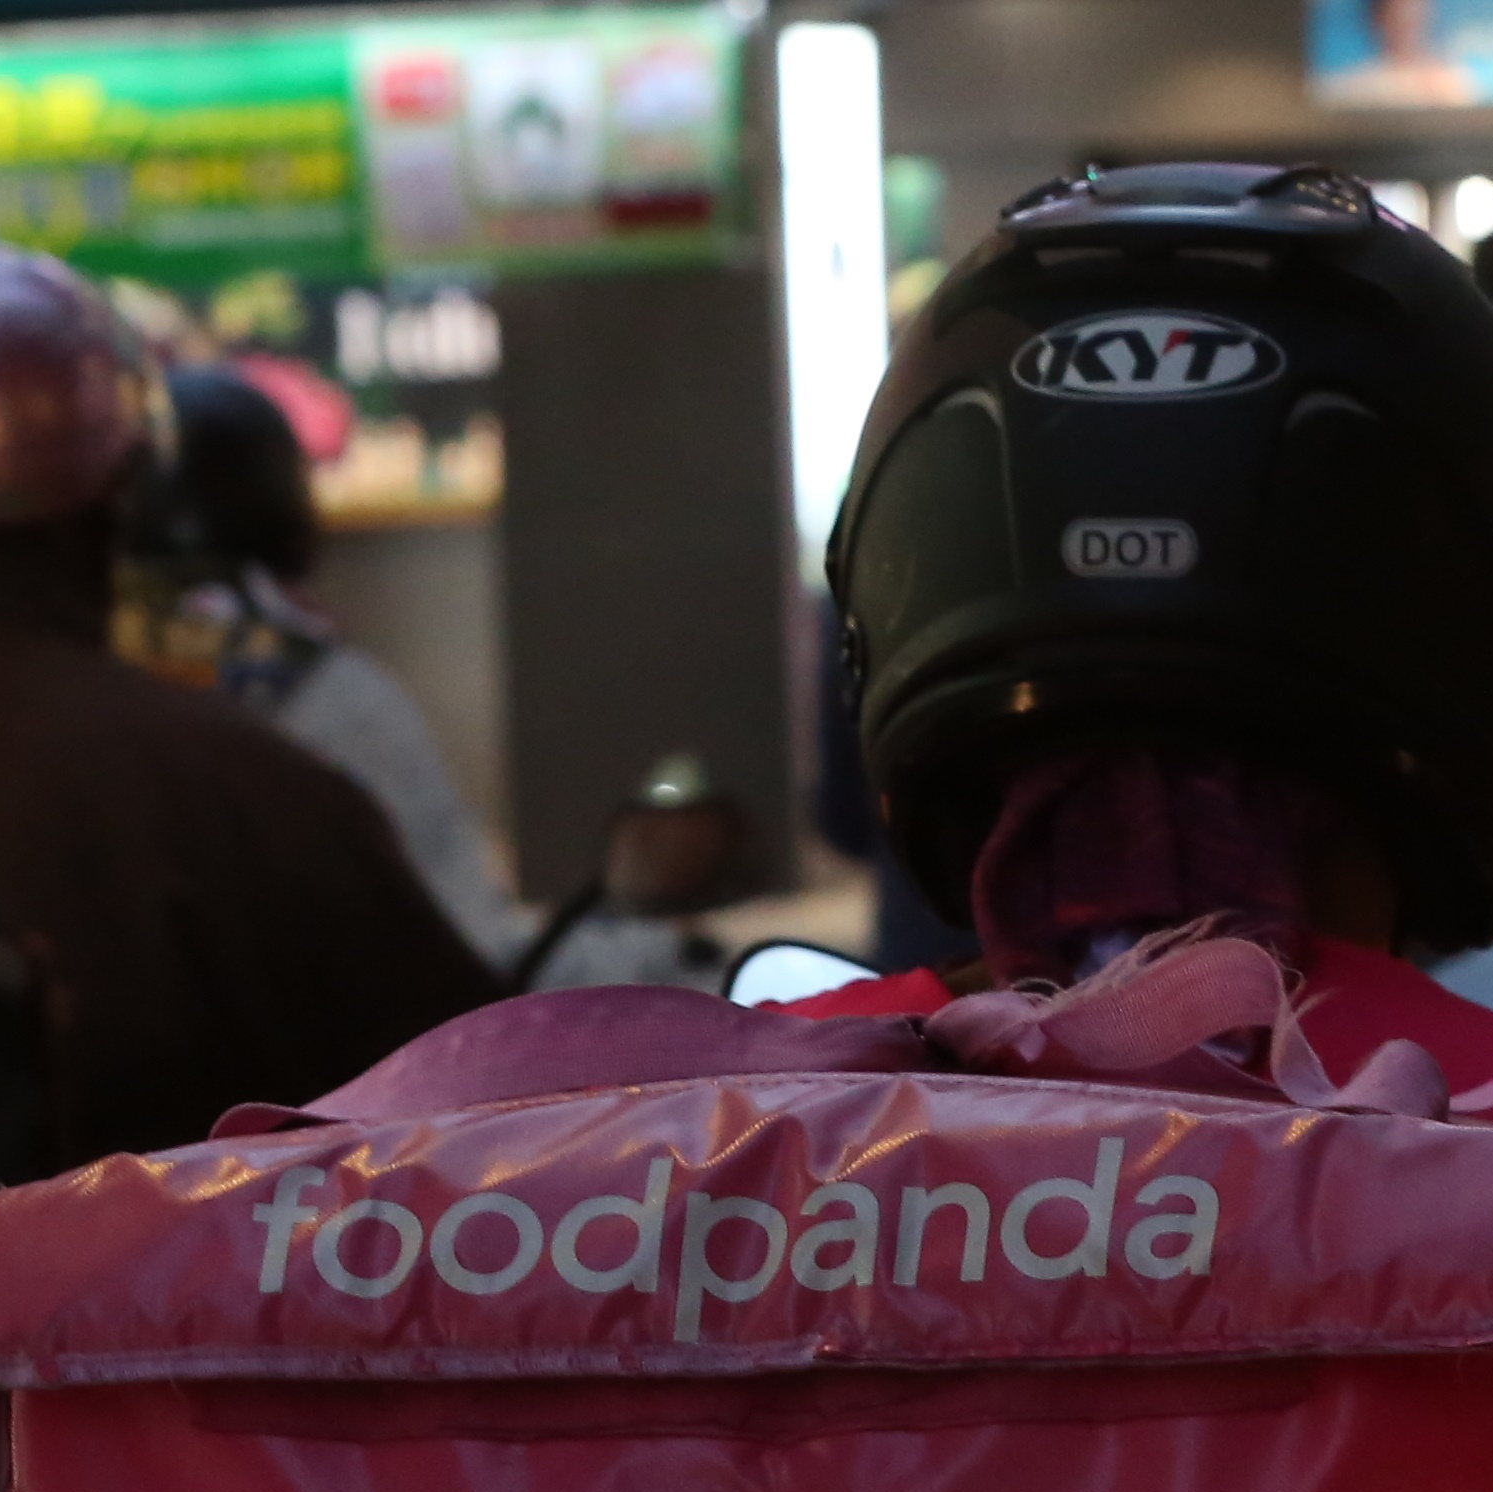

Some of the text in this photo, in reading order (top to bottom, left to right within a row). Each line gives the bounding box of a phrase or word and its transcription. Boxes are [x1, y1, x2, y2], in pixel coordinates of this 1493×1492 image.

[1041, 330, 1247, 385] KYT
[1081, 529, 1179, 566] DOT
[252, 1138, 1219, 1342] foodpanda
